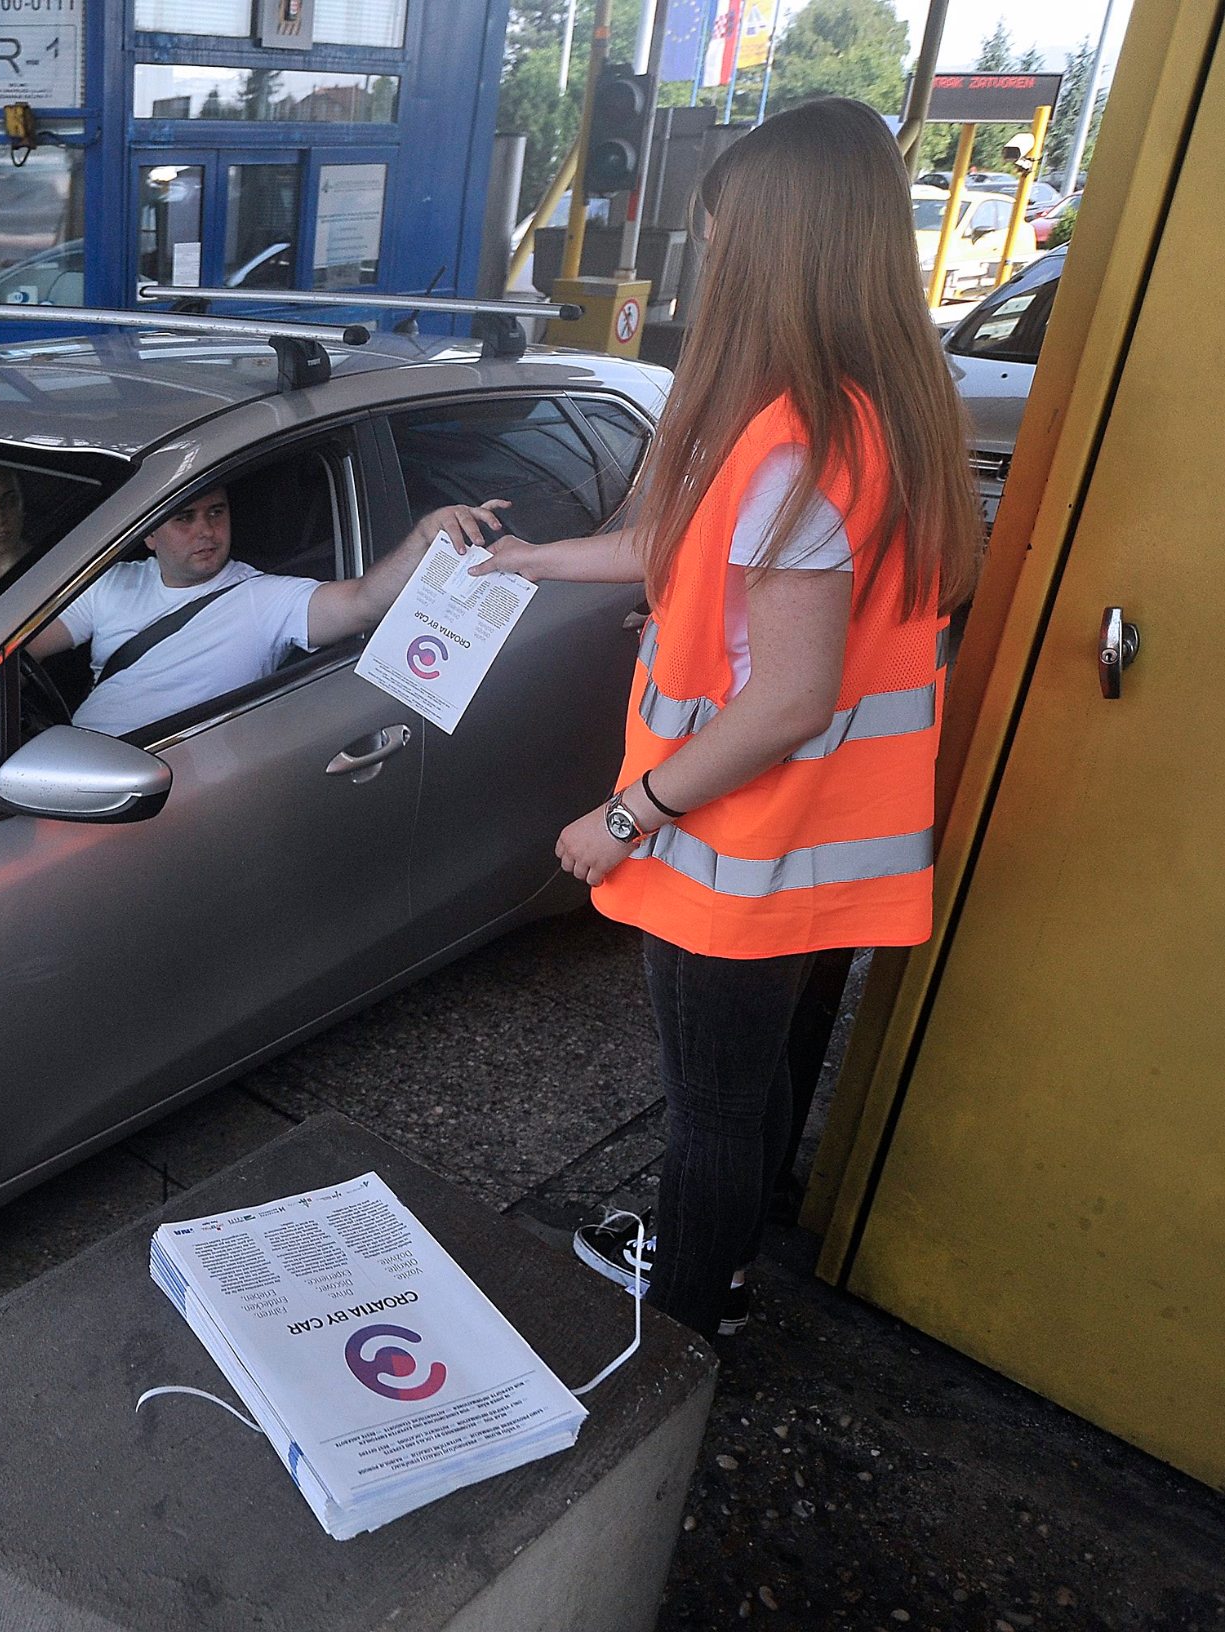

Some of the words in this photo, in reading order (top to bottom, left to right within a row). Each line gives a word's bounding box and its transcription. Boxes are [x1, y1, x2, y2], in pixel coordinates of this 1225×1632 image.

[969, 75, 1036, 89] ZATVOREN
[414, 611, 429, 623] CAR
[427, 620, 439, 629] BY
[439, 626, 471, 649] CROATIA
[377, 1250, 413, 1265] Doživite.
[384, 1258, 418, 1273] Otkrijte.
[304, 1269, 352, 1285] Experience.
[393, 1267, 423, 1280] Vozite.
[315, 1279, 353, 1292] Discover.
[240, 1289, 277, 1302] Erleben.
[328, 1288, 354, 1299] Drive.
[241, 1296, 288, 1312] Entdecken.
[347, 1291, 418, 1317] CROATIA
[254, 1306, 287, 1319] Fahren.
[326, 1310, 349, 1325] BY
[287, 1318, 323, 1335] CAR
